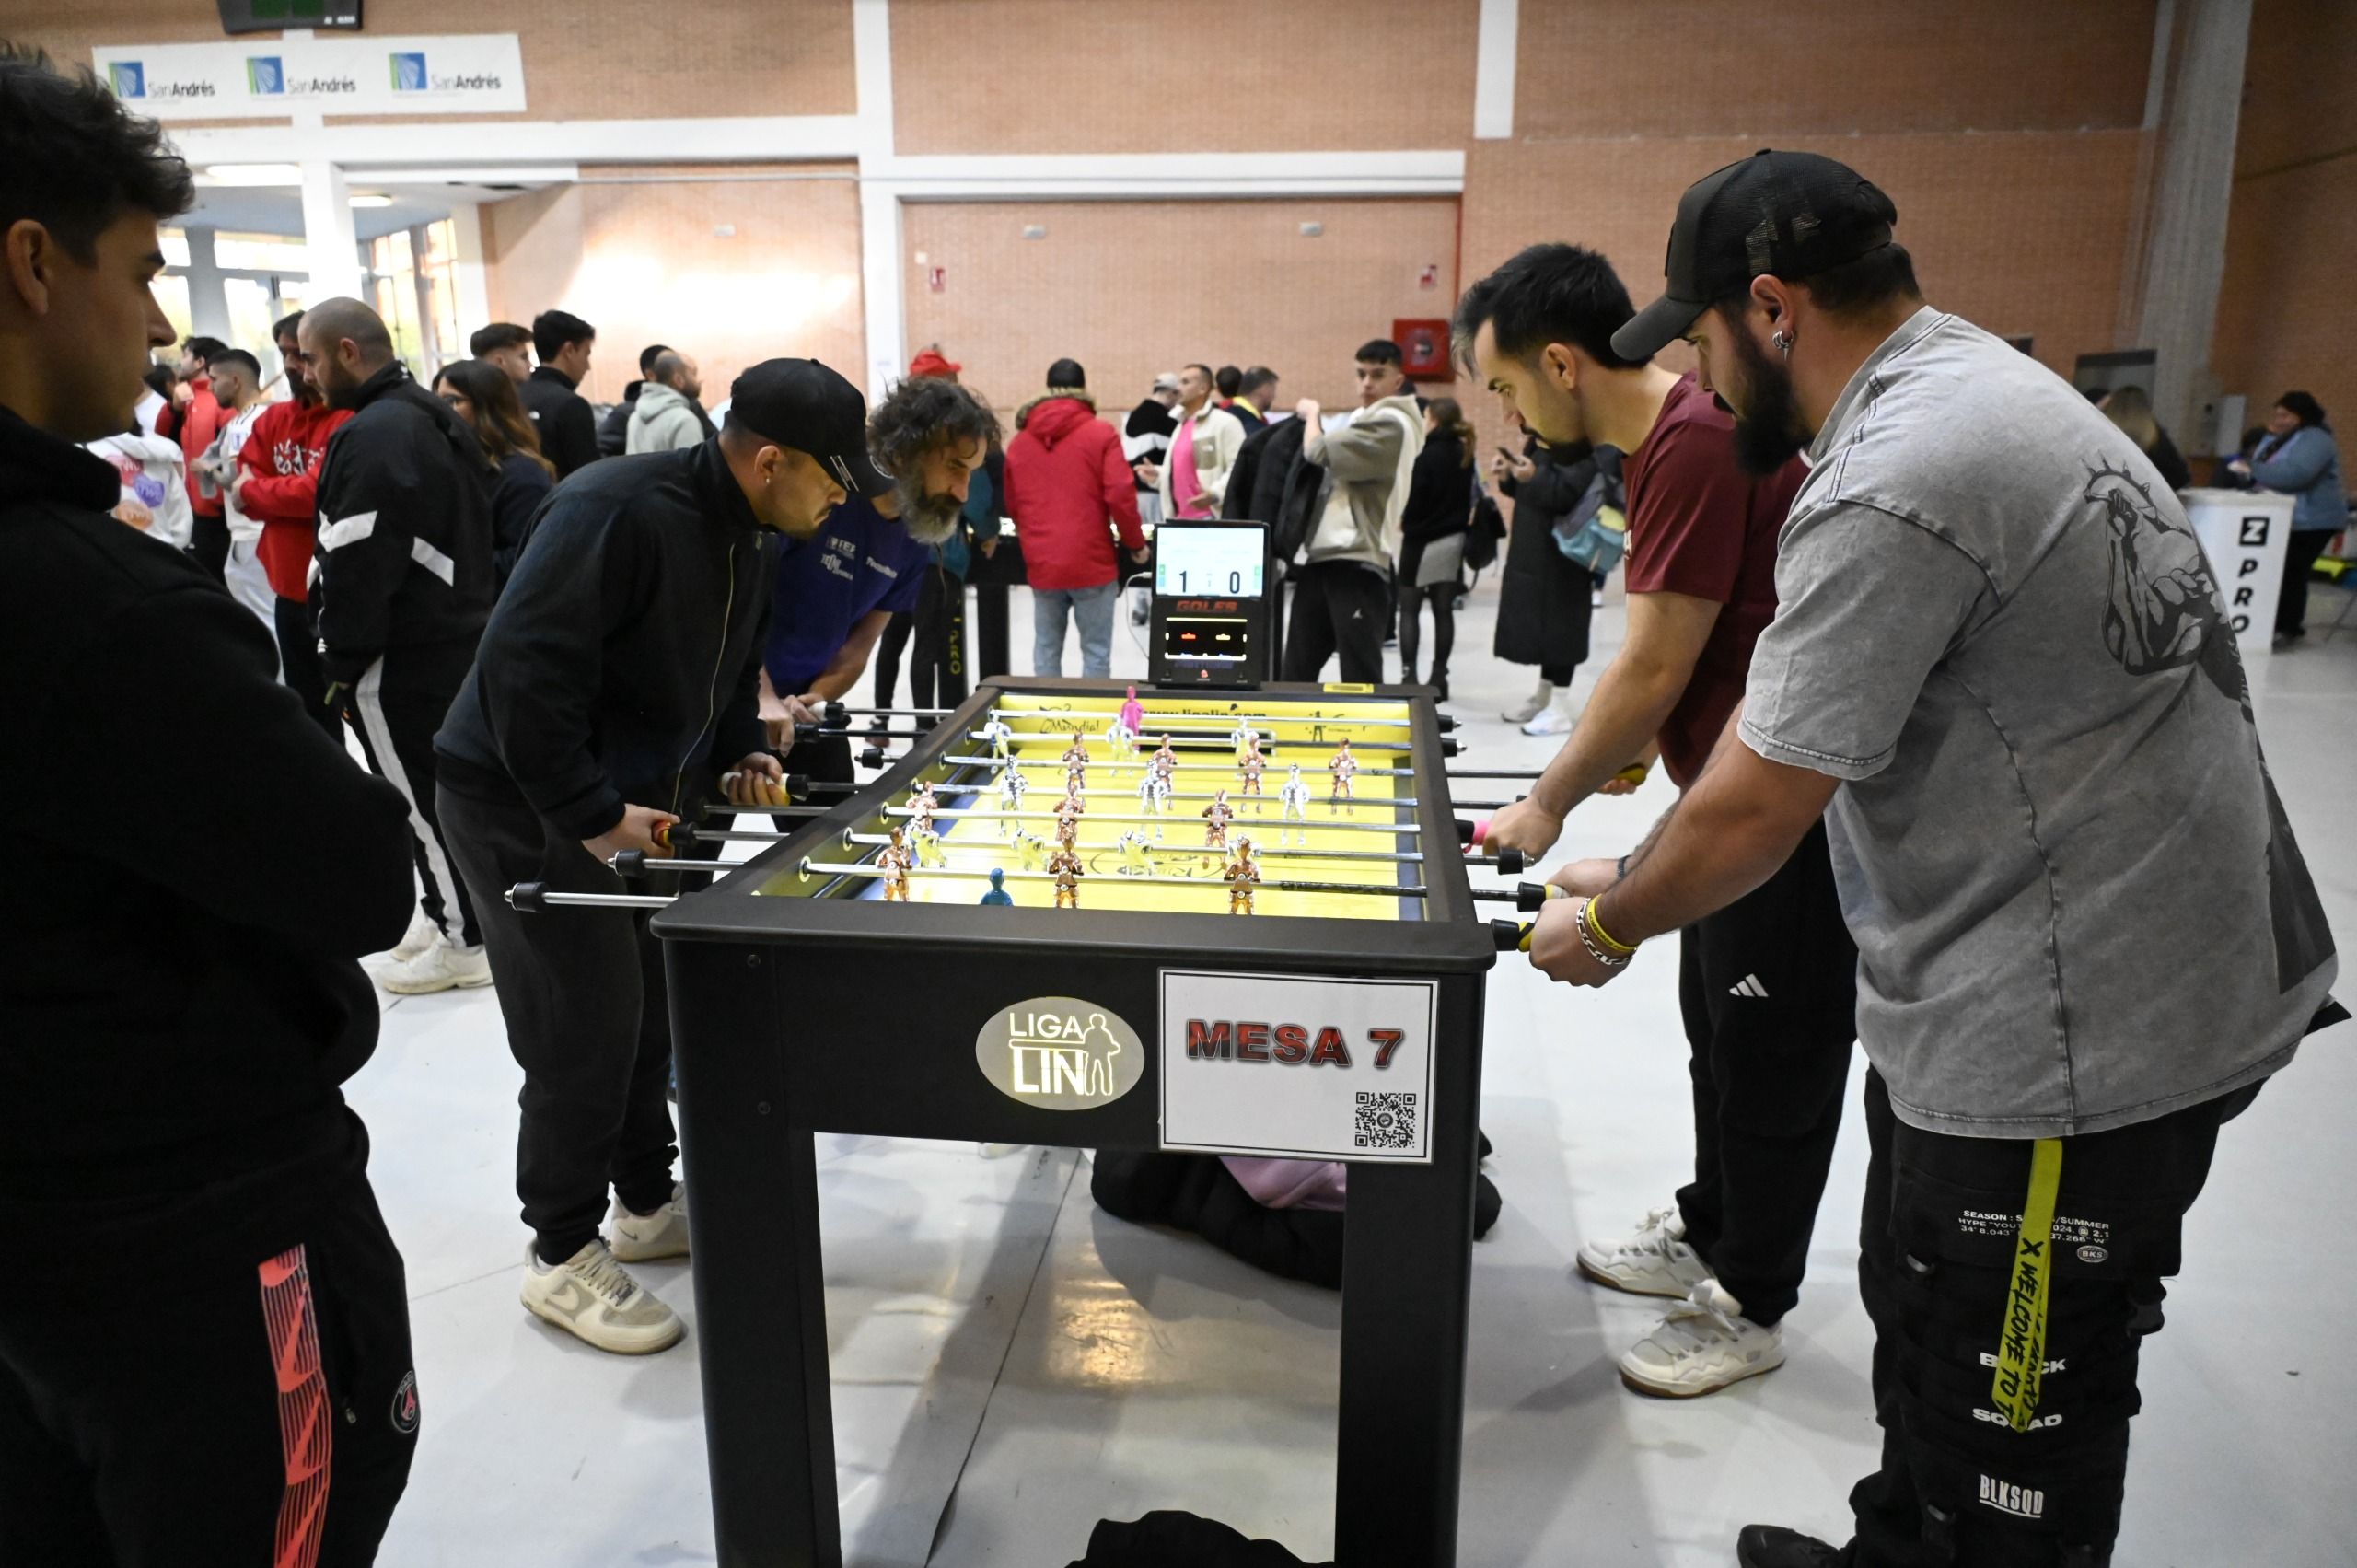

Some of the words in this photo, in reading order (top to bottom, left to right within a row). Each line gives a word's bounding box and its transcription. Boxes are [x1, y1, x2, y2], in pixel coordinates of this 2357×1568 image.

[1178, 570, 1188, 594] 1
[1229, 571, 1241, 595] 0
[1009, 1012, 1084, 1039] LIGA
[1186, 1019, 1352, 1067] MESA
[1367, 1028, 1404, 1069] 7
[1013, 1048, 1085, 1095] LIN
[1958, 1217, 1987, 1227] HYPE
[1963, 1210, 2007, 1221] SEASON
[2082, 1249, 2104, 1259] BKS
[2003, 1260, 2039, 1366] WELCOME
[1980, 1352, 2067, 1374] BCK
[1999, 1366, 2021, 1398] TO
[1972, 1408, 2063, 1431] SQAD
[1980, 1474, 2044, 1516] BLKSQD
